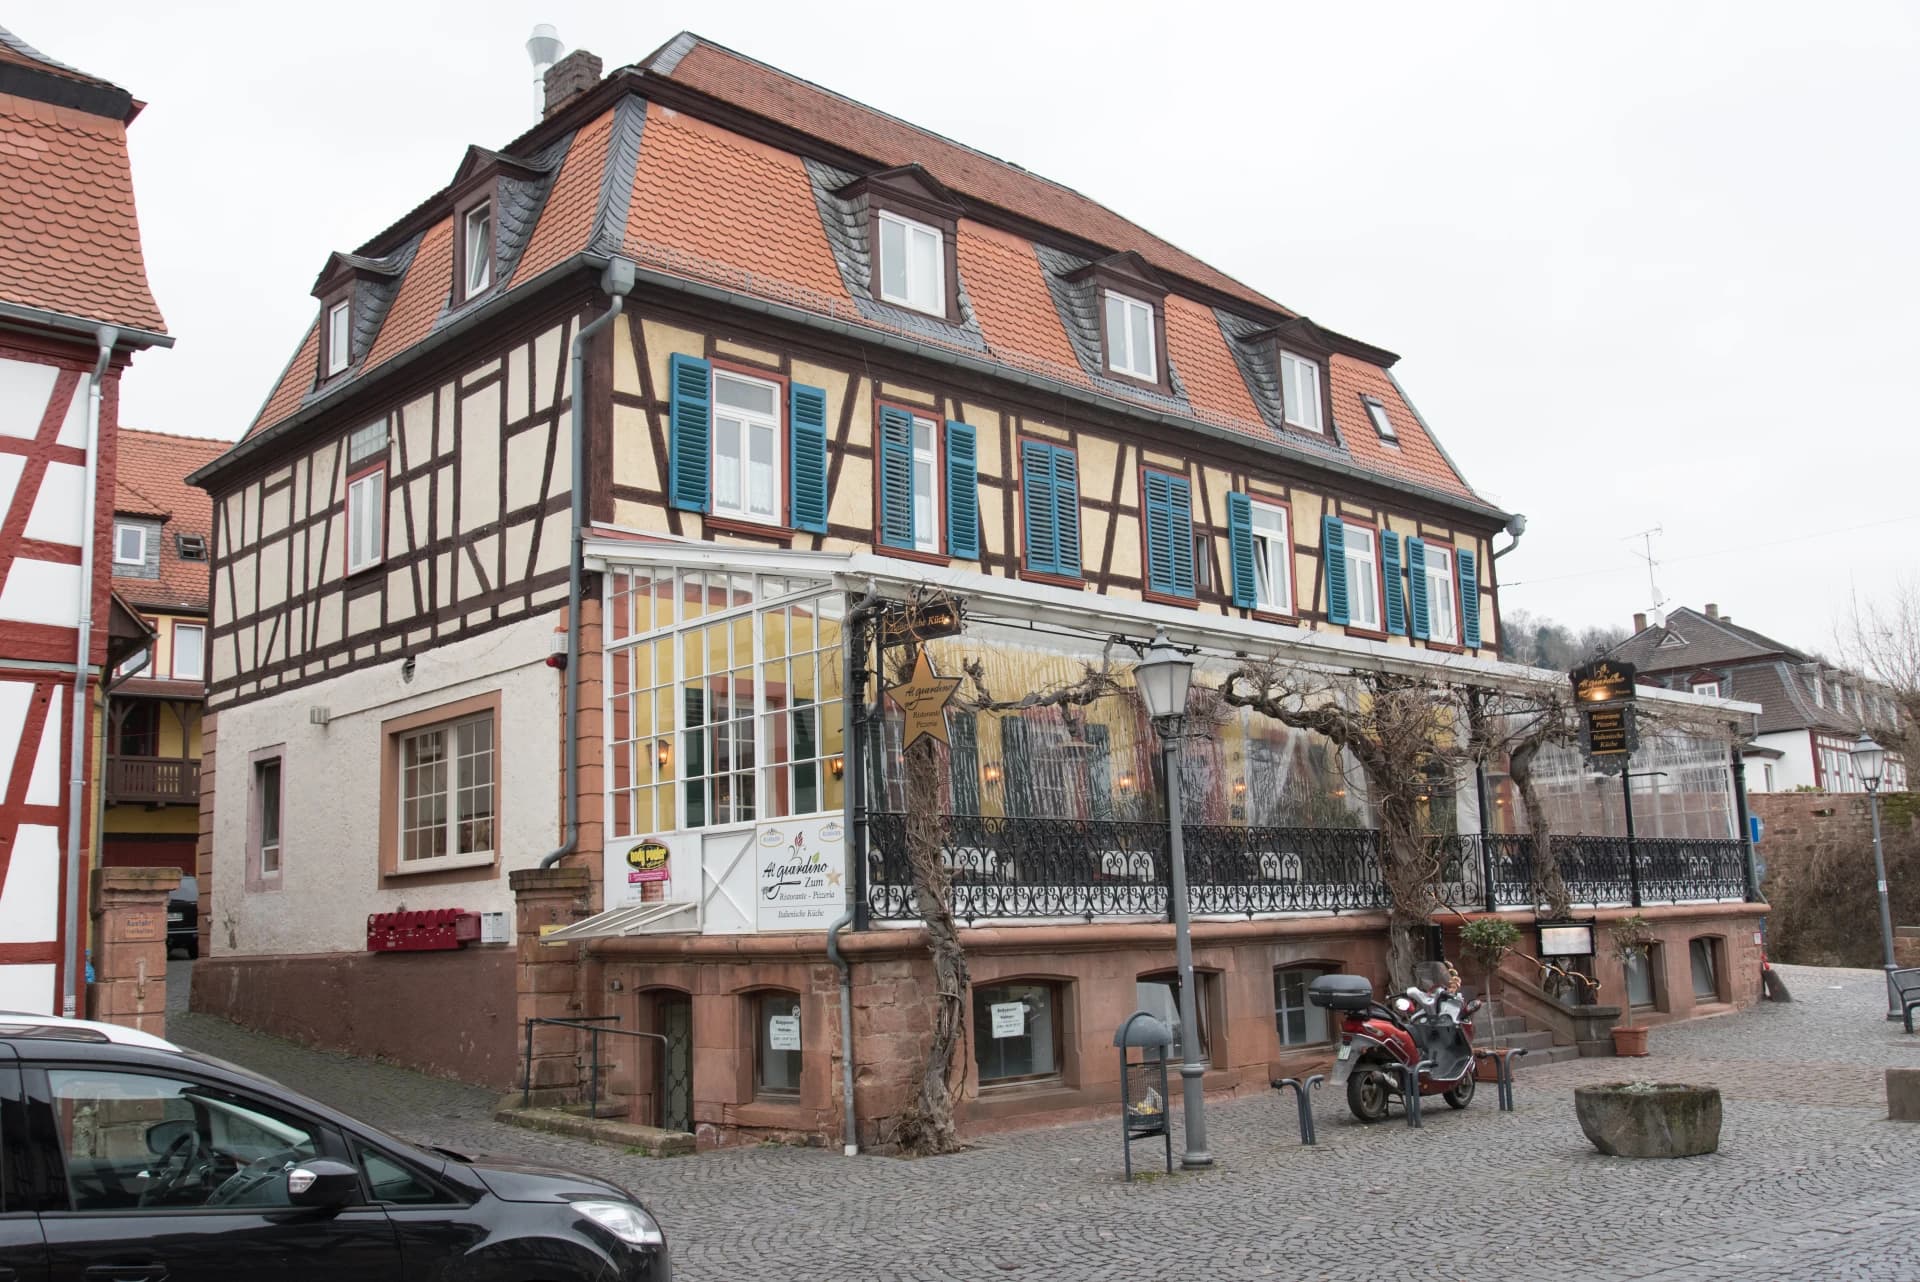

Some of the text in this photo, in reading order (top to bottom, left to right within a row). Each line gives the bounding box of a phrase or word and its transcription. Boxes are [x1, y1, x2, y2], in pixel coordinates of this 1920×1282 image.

[762, 855, 828, 883] Al giardino
[804, 877, 824, 888] Zum
